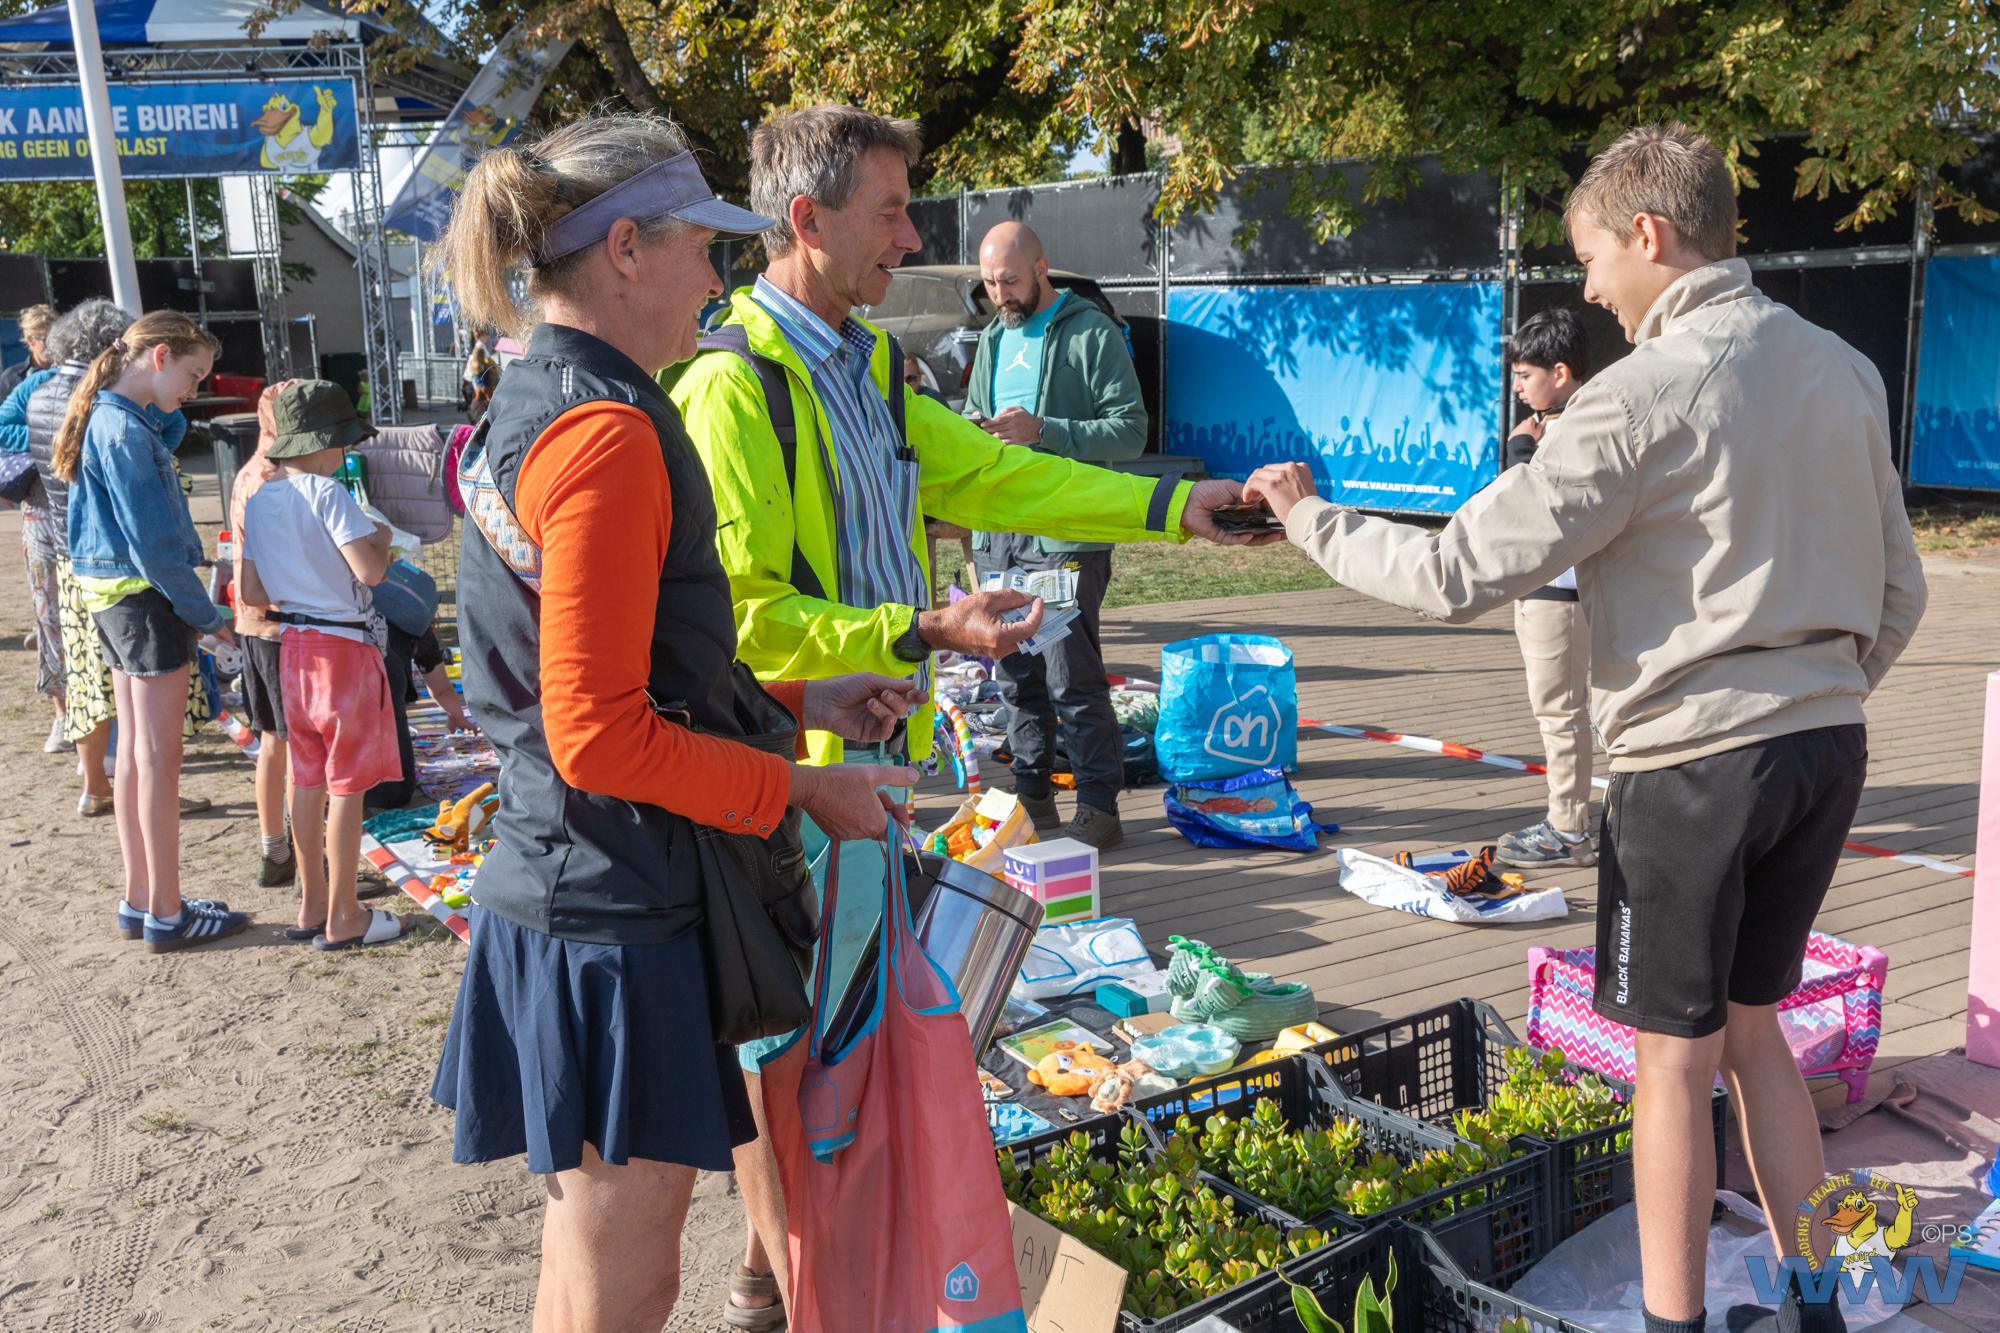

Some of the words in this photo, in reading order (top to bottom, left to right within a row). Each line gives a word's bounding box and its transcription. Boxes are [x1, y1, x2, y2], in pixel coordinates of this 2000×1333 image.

[26, 107, 84, 134] AAN
[137, 103, 239, 132] BUREN!
[22, 140, 70, 158] GEEN
[1014, 576, 1024, 588] 5
[1616, 964, 1629, 1005] BLACK
